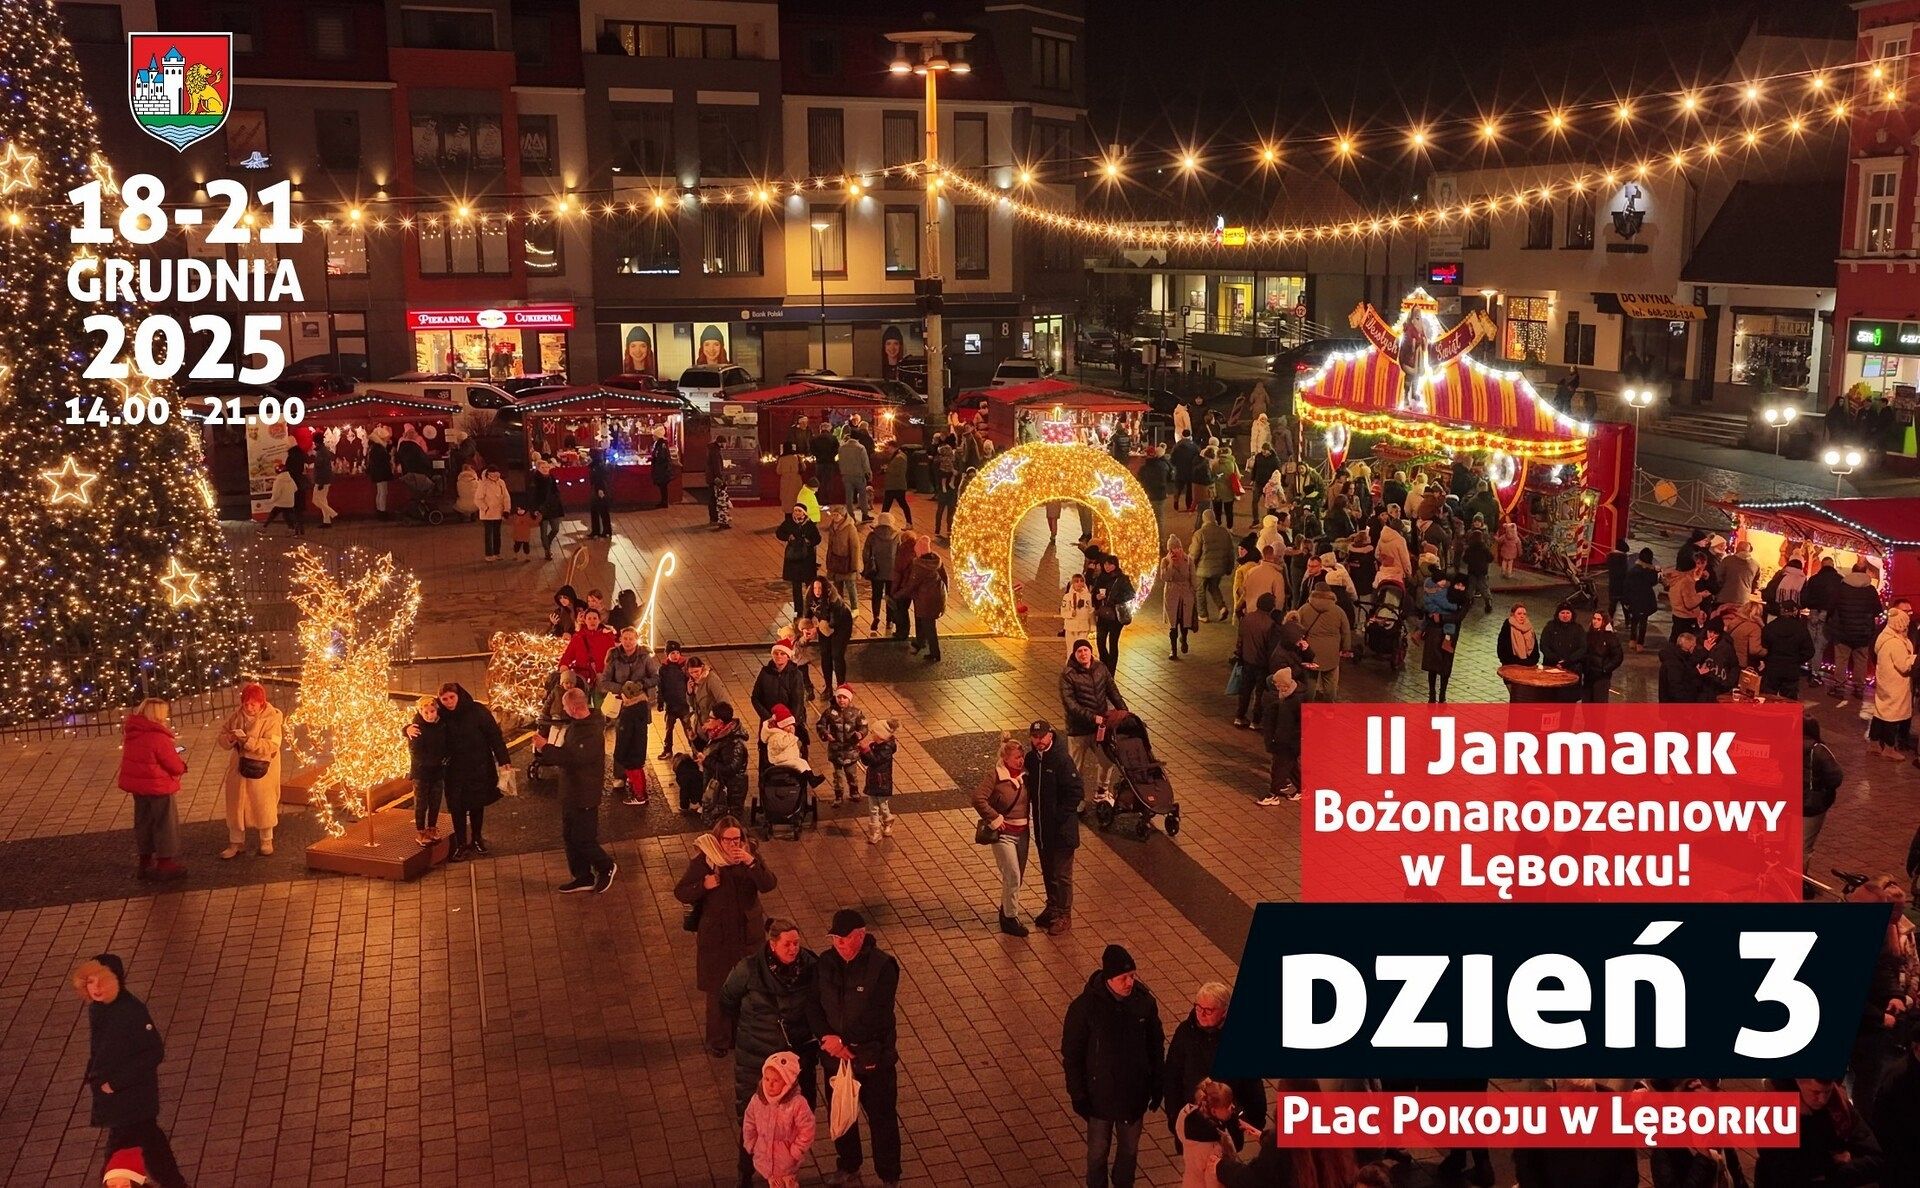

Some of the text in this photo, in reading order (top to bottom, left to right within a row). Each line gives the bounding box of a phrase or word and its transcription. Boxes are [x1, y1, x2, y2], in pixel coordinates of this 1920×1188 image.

[1621, 293, 1636, 303] DO
[767, 310, 784, 318] Polski
[1182, 306, 1189, 315] P
[1632, 308, 1646, 317] tel.
[1002, 322, 1010, 336] 8
